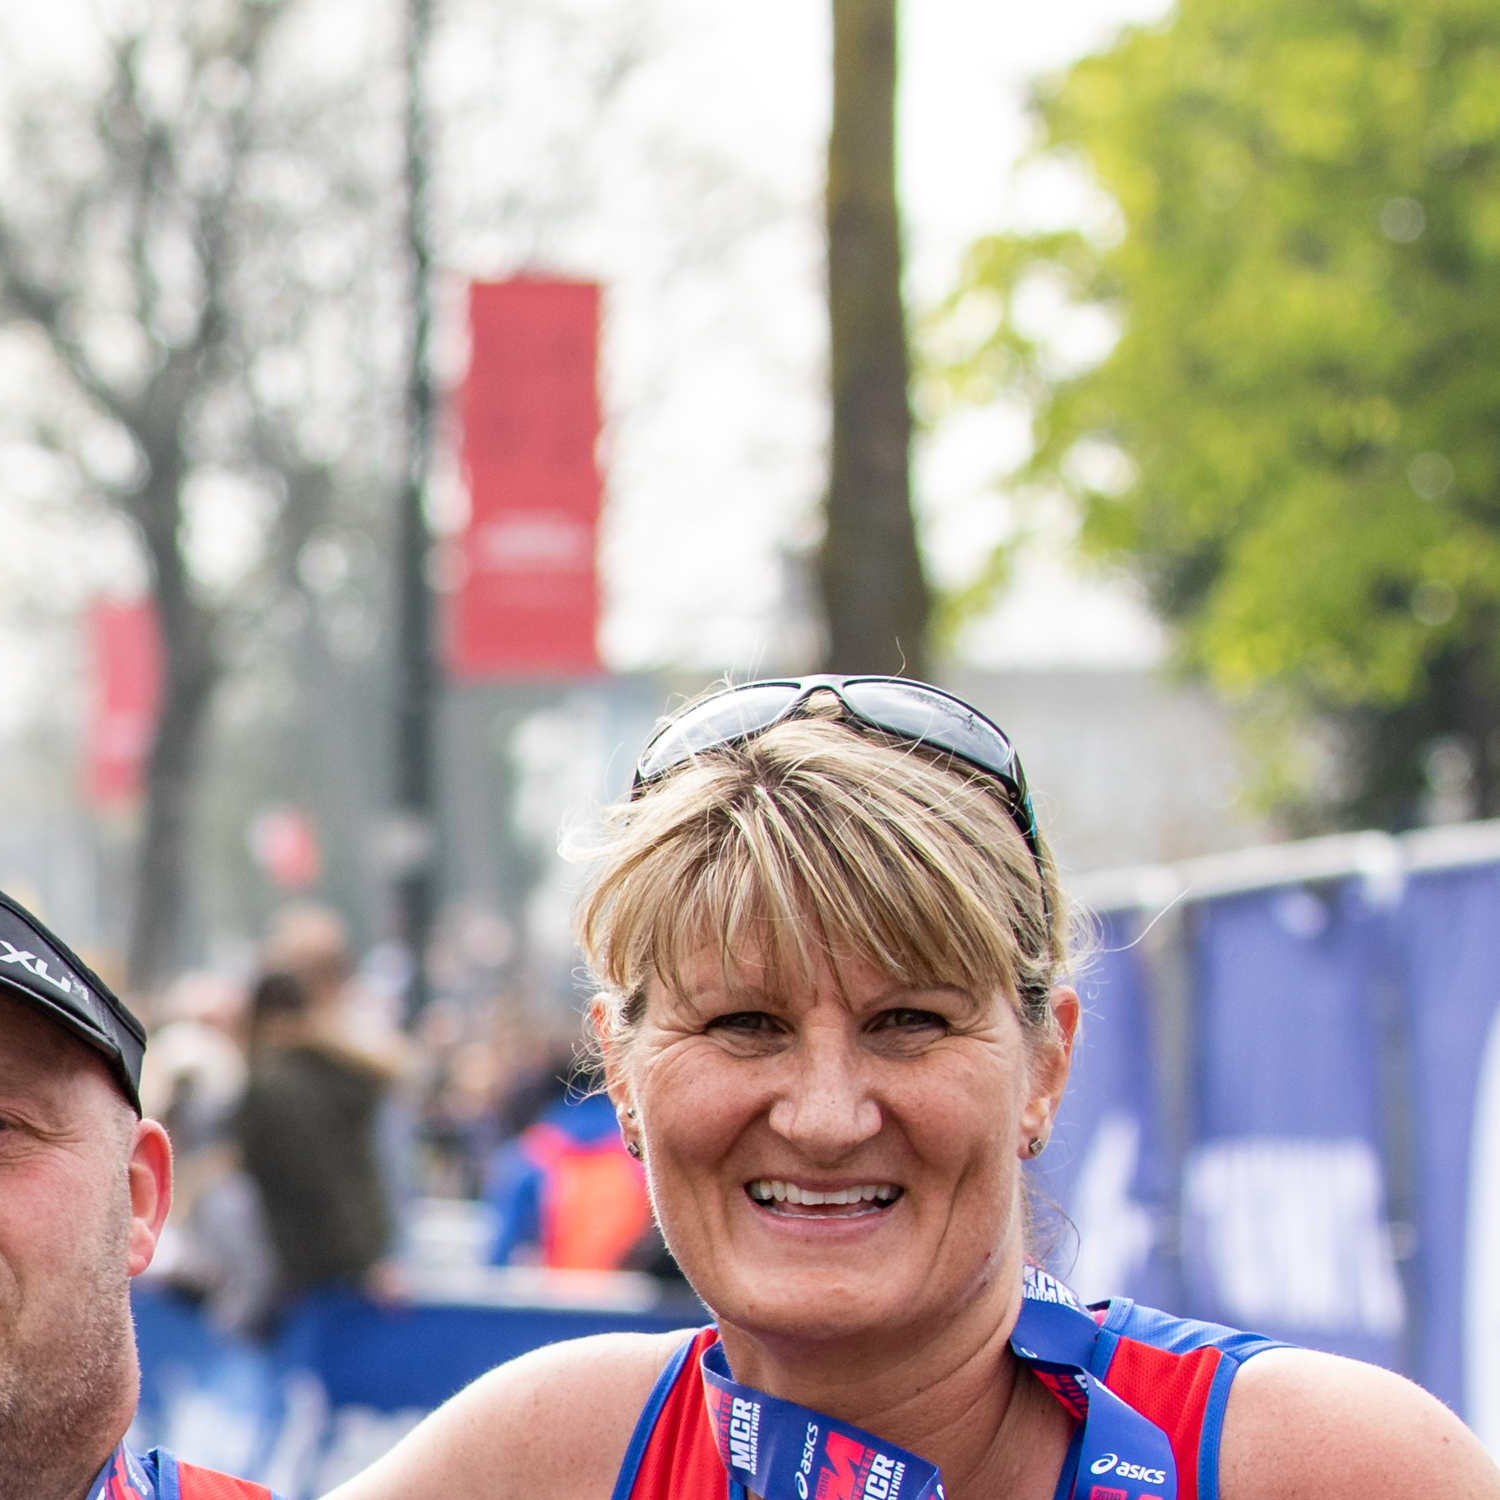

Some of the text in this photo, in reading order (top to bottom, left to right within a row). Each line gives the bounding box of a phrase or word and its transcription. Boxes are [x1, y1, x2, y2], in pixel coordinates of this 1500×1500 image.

[729, 1397, 752, 1472] MCR
[750, 1402, 762, 1476] MARATHON
[816, 1469, 831, 1499] 2019
